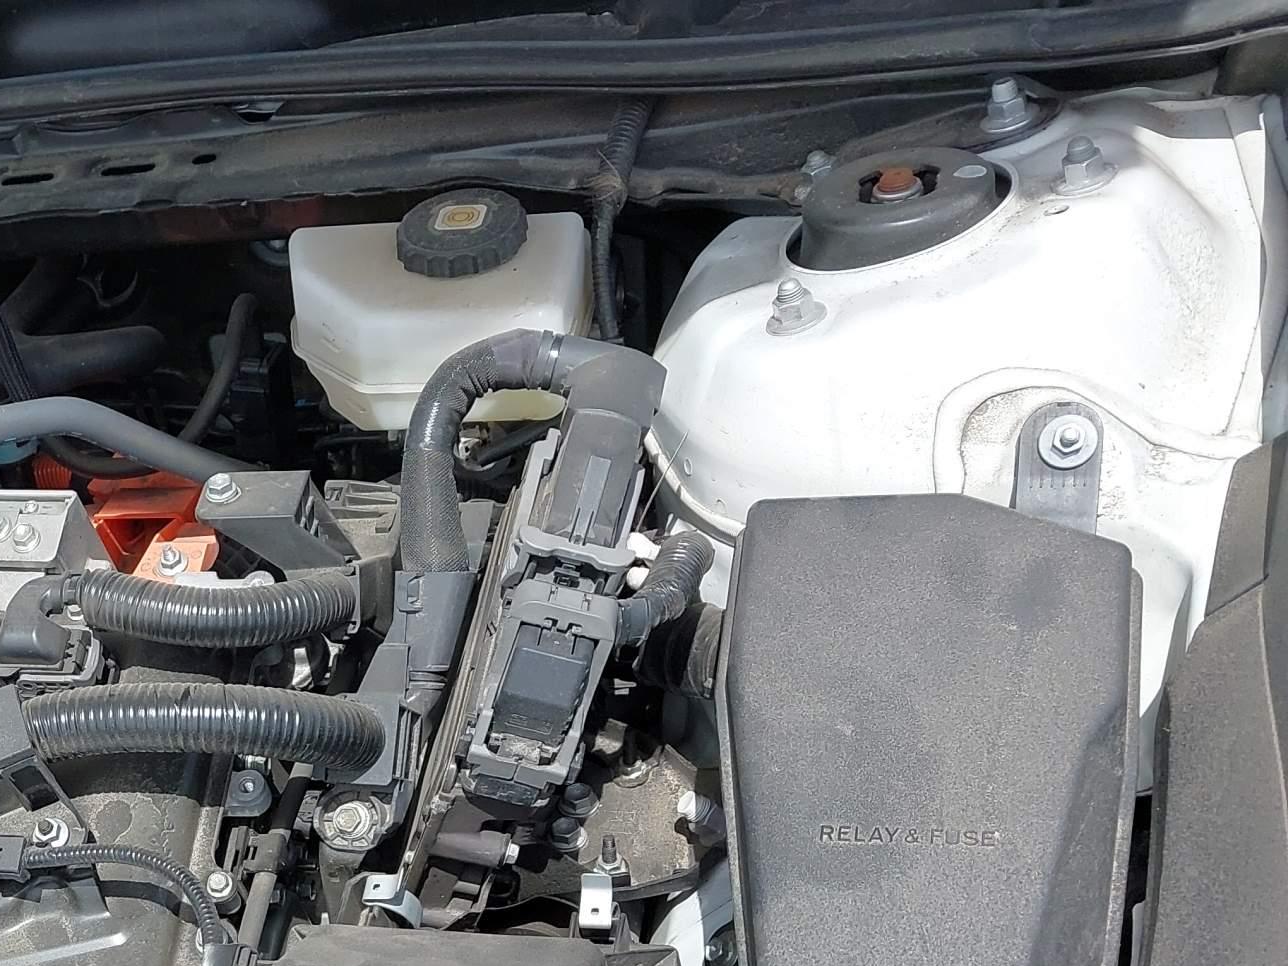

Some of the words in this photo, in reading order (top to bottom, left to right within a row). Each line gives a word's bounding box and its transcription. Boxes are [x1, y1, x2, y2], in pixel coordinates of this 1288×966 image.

[819, 825, 900, 843] RELAY
[904, 829, 920, 844] &
[930, 829, 996, 847] FUSE
